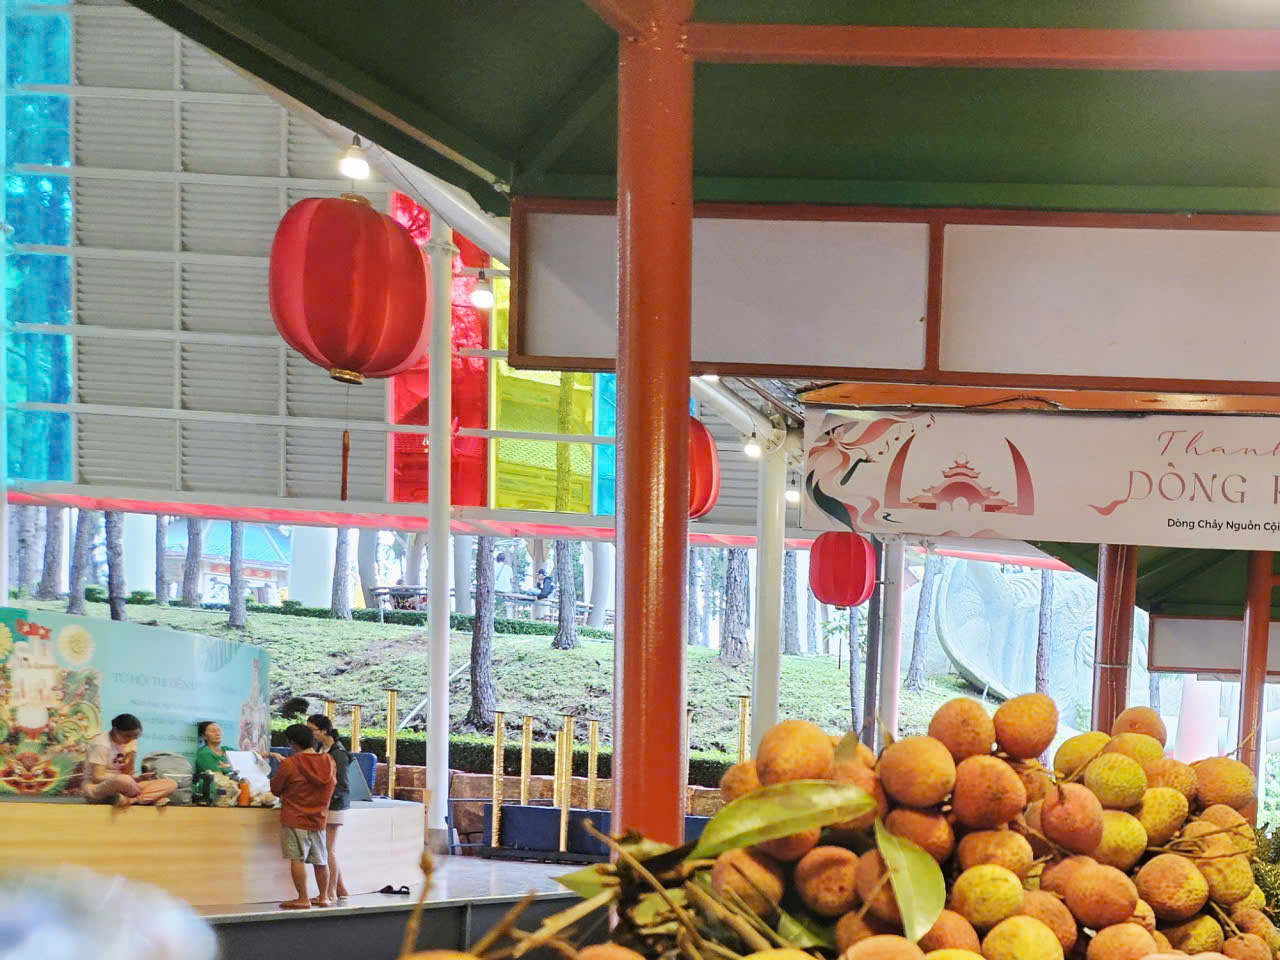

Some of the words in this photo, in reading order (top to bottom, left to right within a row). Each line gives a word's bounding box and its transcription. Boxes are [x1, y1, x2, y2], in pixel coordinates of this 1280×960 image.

[1118, 462, 1247, 505] DÒNG
[1167, 518, 1195, 530] Dòng
[1198, 519, 1223, 531] Chảy
[1226, 519, 1261, 532] Nguồn
[1263, 521, 1280, 534] Cội
